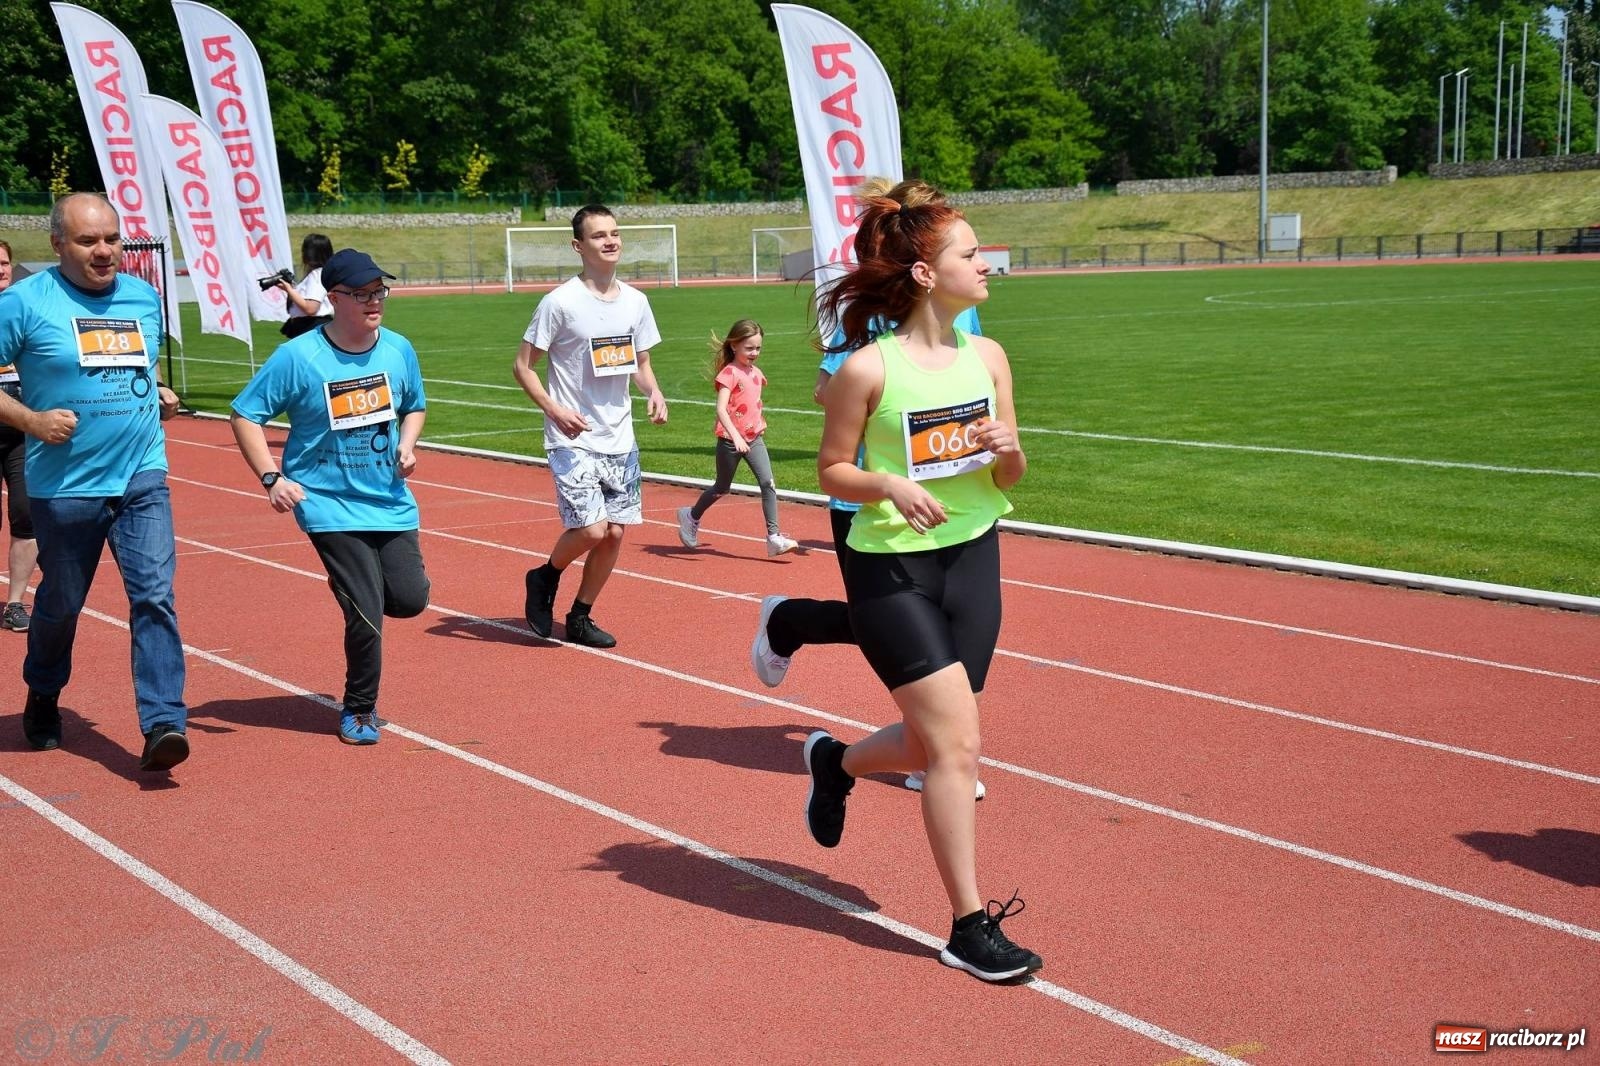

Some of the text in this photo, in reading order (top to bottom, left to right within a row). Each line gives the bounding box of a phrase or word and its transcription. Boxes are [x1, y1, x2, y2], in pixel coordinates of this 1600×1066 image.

[95, 332, 130, 351] 128
[601, 346, 627, 364] 064
[345, 391, 379, 412] 130
